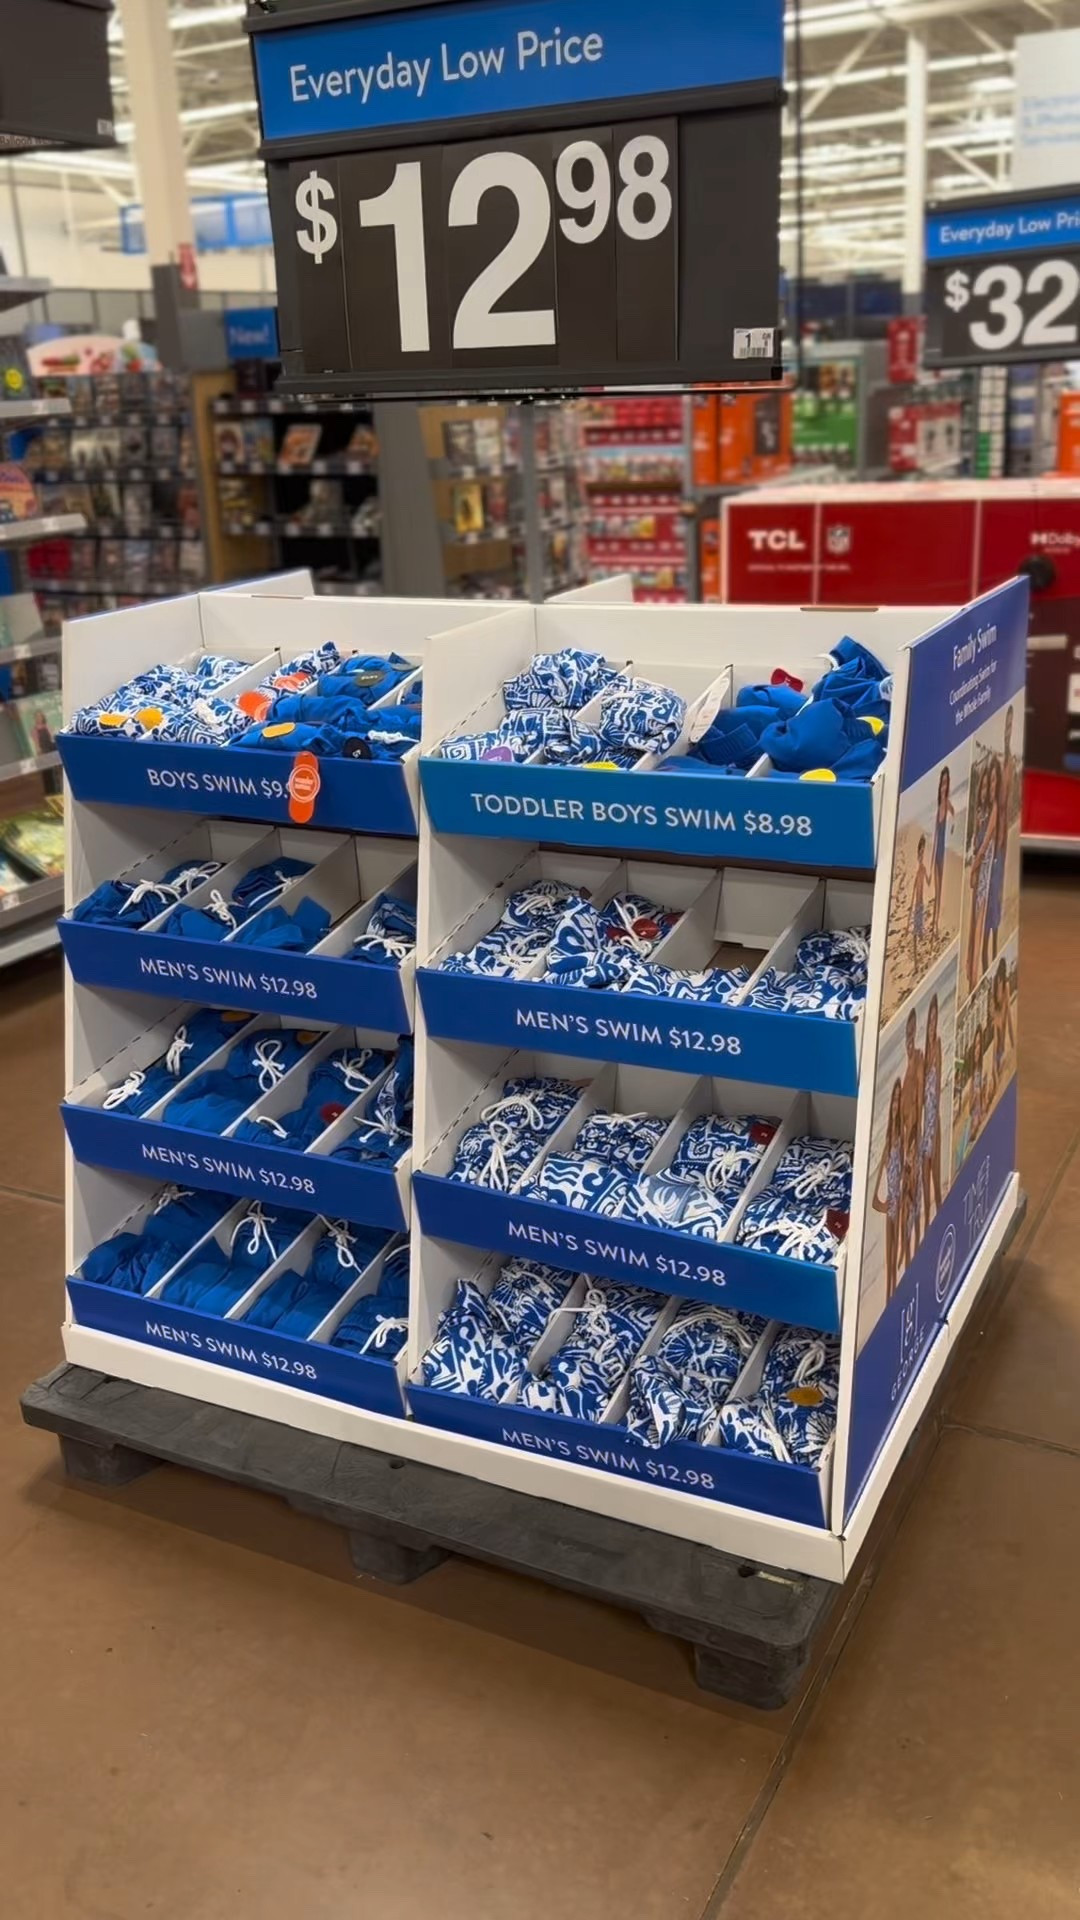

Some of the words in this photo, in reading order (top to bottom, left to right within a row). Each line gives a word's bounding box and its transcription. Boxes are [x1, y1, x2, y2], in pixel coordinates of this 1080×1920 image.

[289, 51, 431, 104] Everyday
[441, 43, 505, 81] Low
[517, 26, 604, 71] Price
[940, 219, 1014, 244] Everyday
[1019, 215, 1051, 234] Low
[748, 529, 806, 551] TCL
[147, 769, 199, 790] BOYS
[202, 774, 258, 796] SWIM
[471, 793, 584, 820] TODDLER
[592, 802, 657, 825] BOYS
[666, 807, 736, 831] SWIM
[744, 809, 812, 836] $8.98
[140, 957, 199, 981] MEN'S
[202, 966, 257, 990] SWIM
[260, 973, 318, 999] $12.98
[516, 1008, 589, 1034] MEN'S
[595, 1018, 662, 1045] SWIM
[669, 1026, 742, 1056] $12.98
[142, 1143, 199, 1169] MEN'S
[202, 1157, 256, 1182] SWIM
[259, 1167, 316, 1195] $12.98
[508, 1220, 579, 1251] MEN'S
[584, 1239, 649, 1268] SWIM
[655, 1254, 727, 1287] $12.98
[145, 1320, 202, 1349] MEN'S
[205, 1337, 258, 1364] SWIM
[261, 1351, 318, 1380] $12.98
[502, 1428, 572, 1456] MEN'S
[578, 1445, 641, 1473] SWIM
[645, 1461, 715, 1490] $12.98
